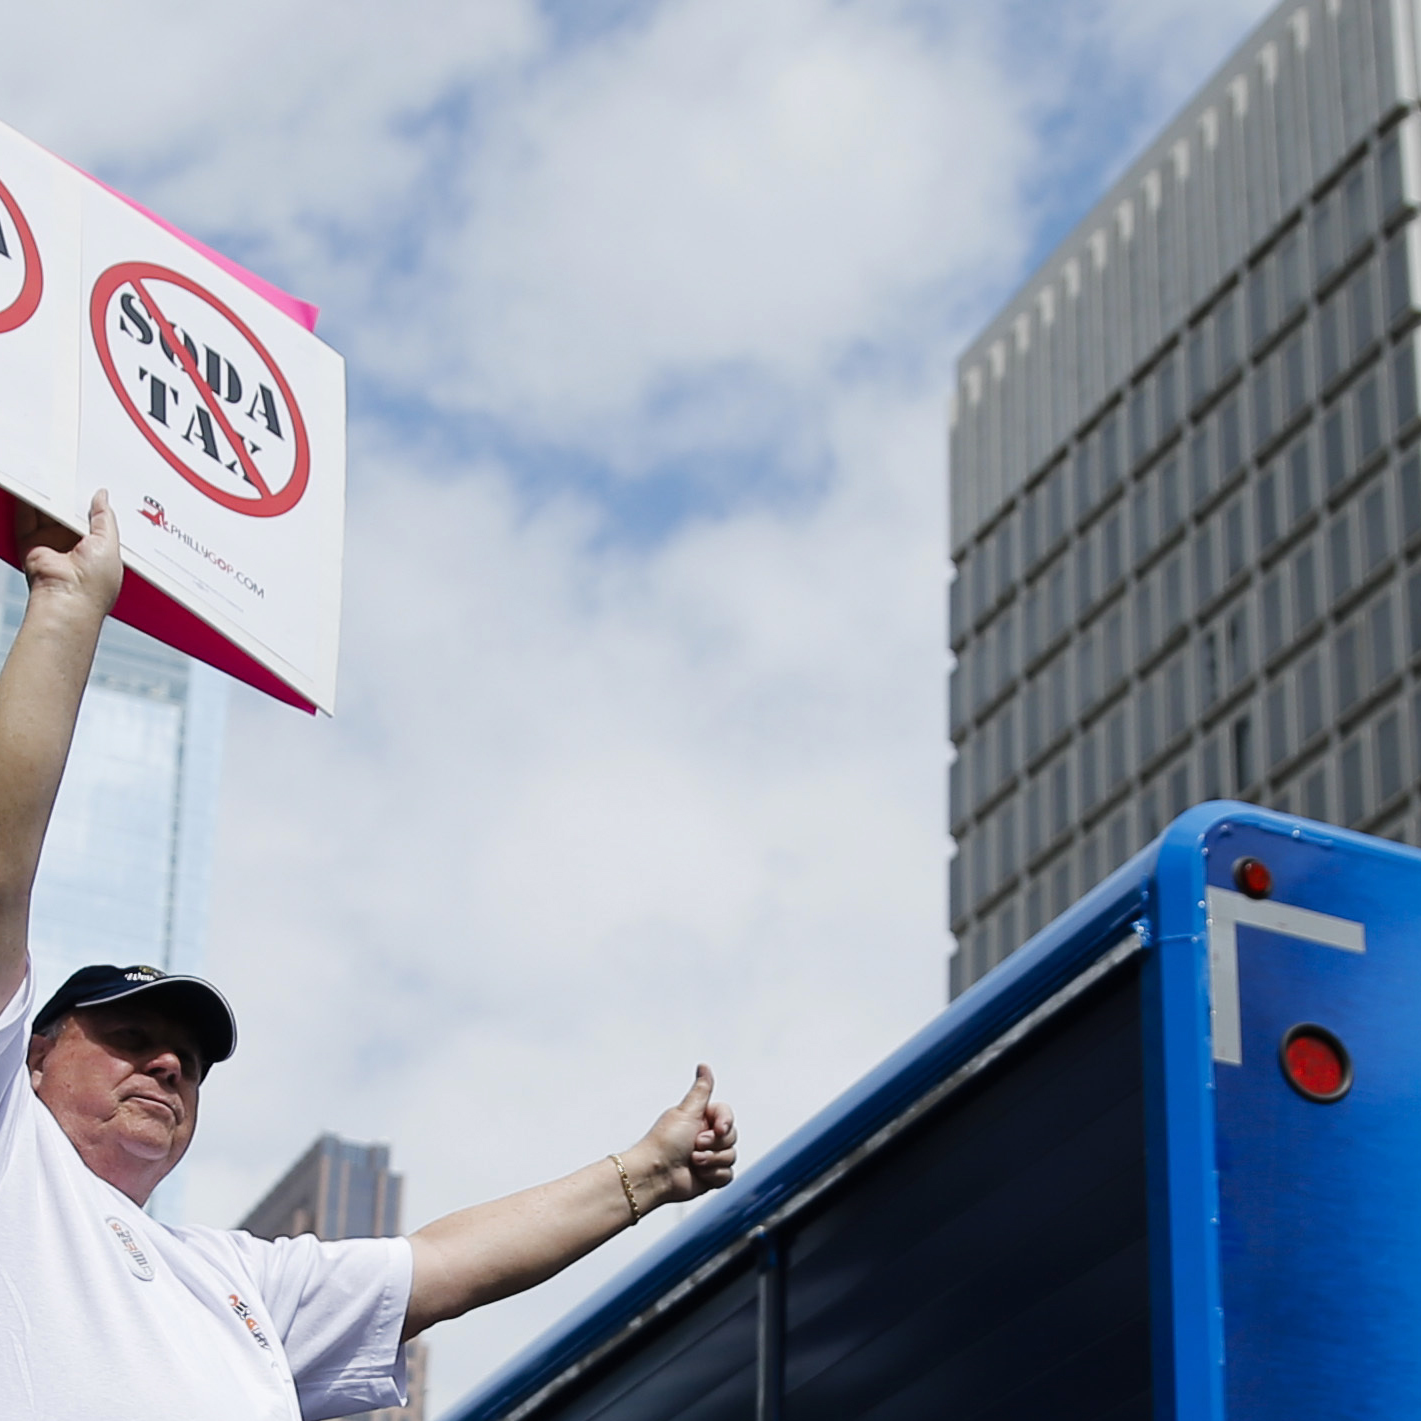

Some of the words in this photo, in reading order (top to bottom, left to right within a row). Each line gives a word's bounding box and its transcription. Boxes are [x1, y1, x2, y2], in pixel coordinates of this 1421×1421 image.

[118, 292, 285, 441] SODA
[138, 366, 262, 489] TAX
[170, 523, 266, 599] PHILLYGOP.COM
